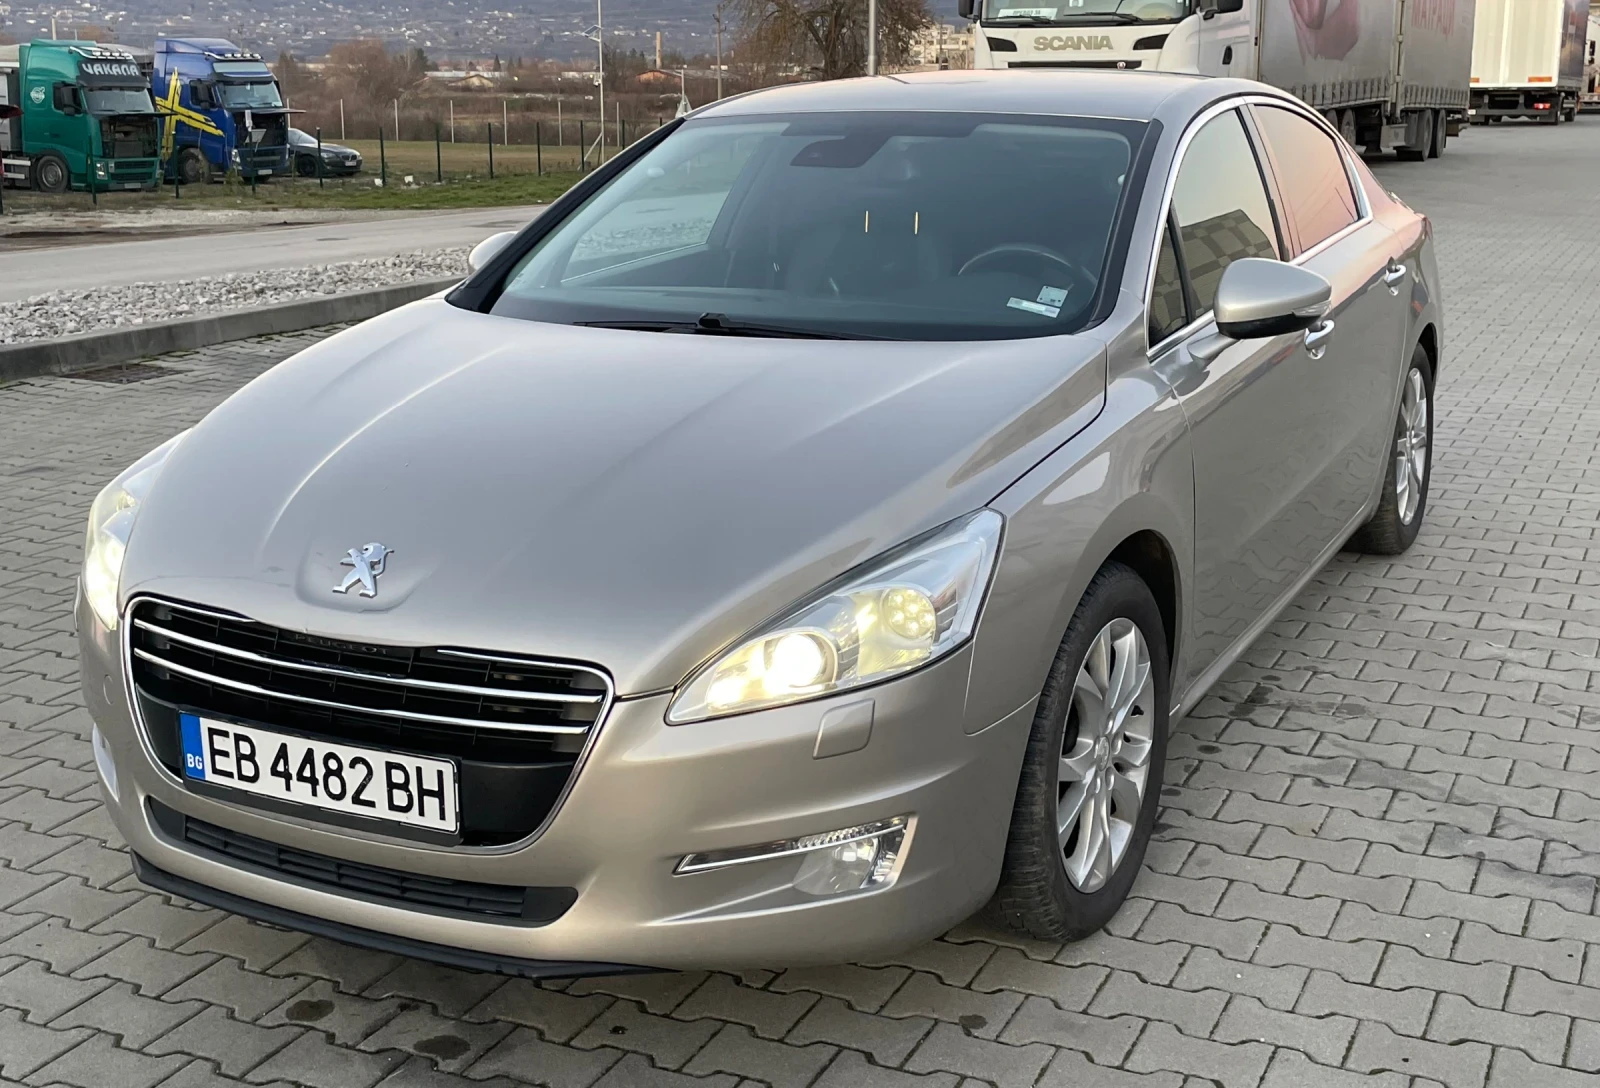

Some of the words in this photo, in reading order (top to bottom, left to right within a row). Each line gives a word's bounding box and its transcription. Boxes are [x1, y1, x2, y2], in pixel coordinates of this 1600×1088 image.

[1033, 35, 1114, 51] SCANIA
[186, 753, 203, 770] BG
[207, 727, 260, 784] EB
[270, 742, 376, 808] 4482
[385, 760, 446, 821] BH
